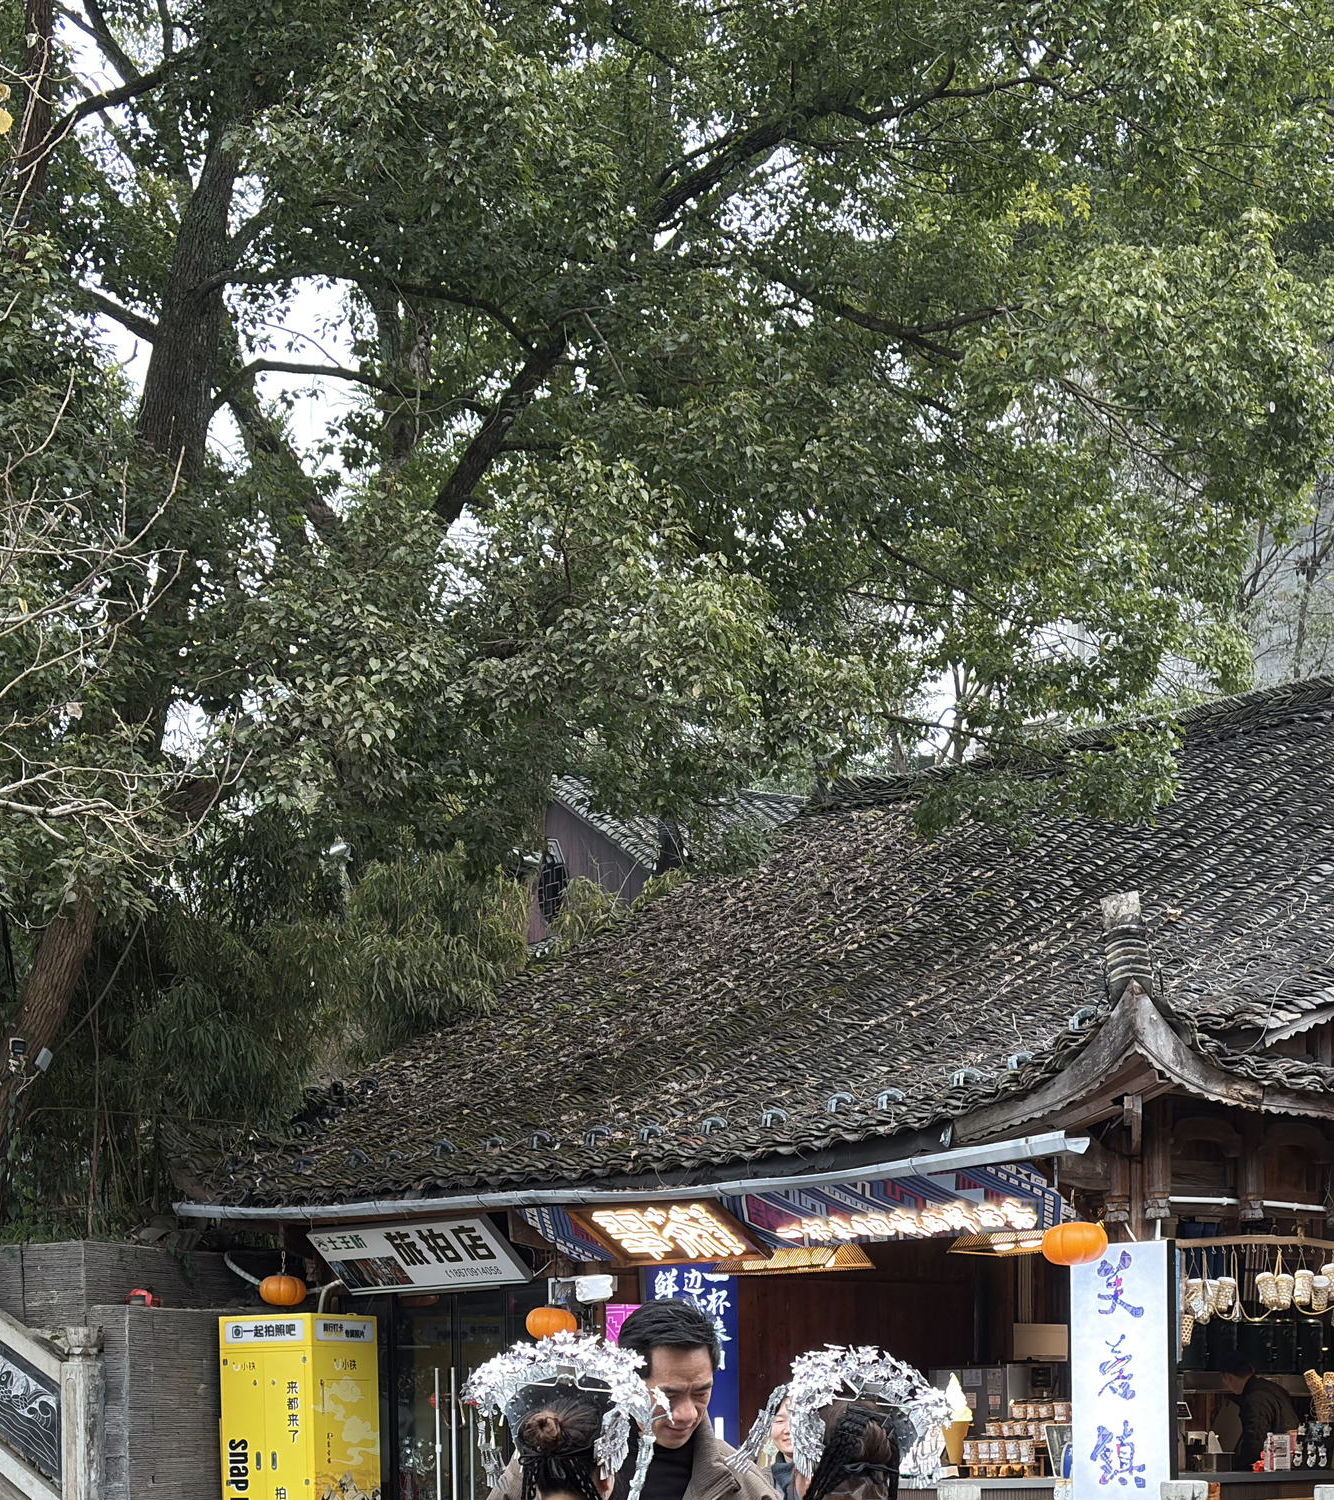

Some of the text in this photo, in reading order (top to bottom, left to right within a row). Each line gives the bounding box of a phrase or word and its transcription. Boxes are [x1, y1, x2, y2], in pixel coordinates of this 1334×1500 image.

[383, 1226, 497, 1266] 旅拍店
[449, 1266, 502, 1278] 18670914058
[243, 1324, 296, 1338] 一起拍照吧
[702, 1272, 732, 1370] 一杯来
[286, 1381, 299, 1443] 来都来了
